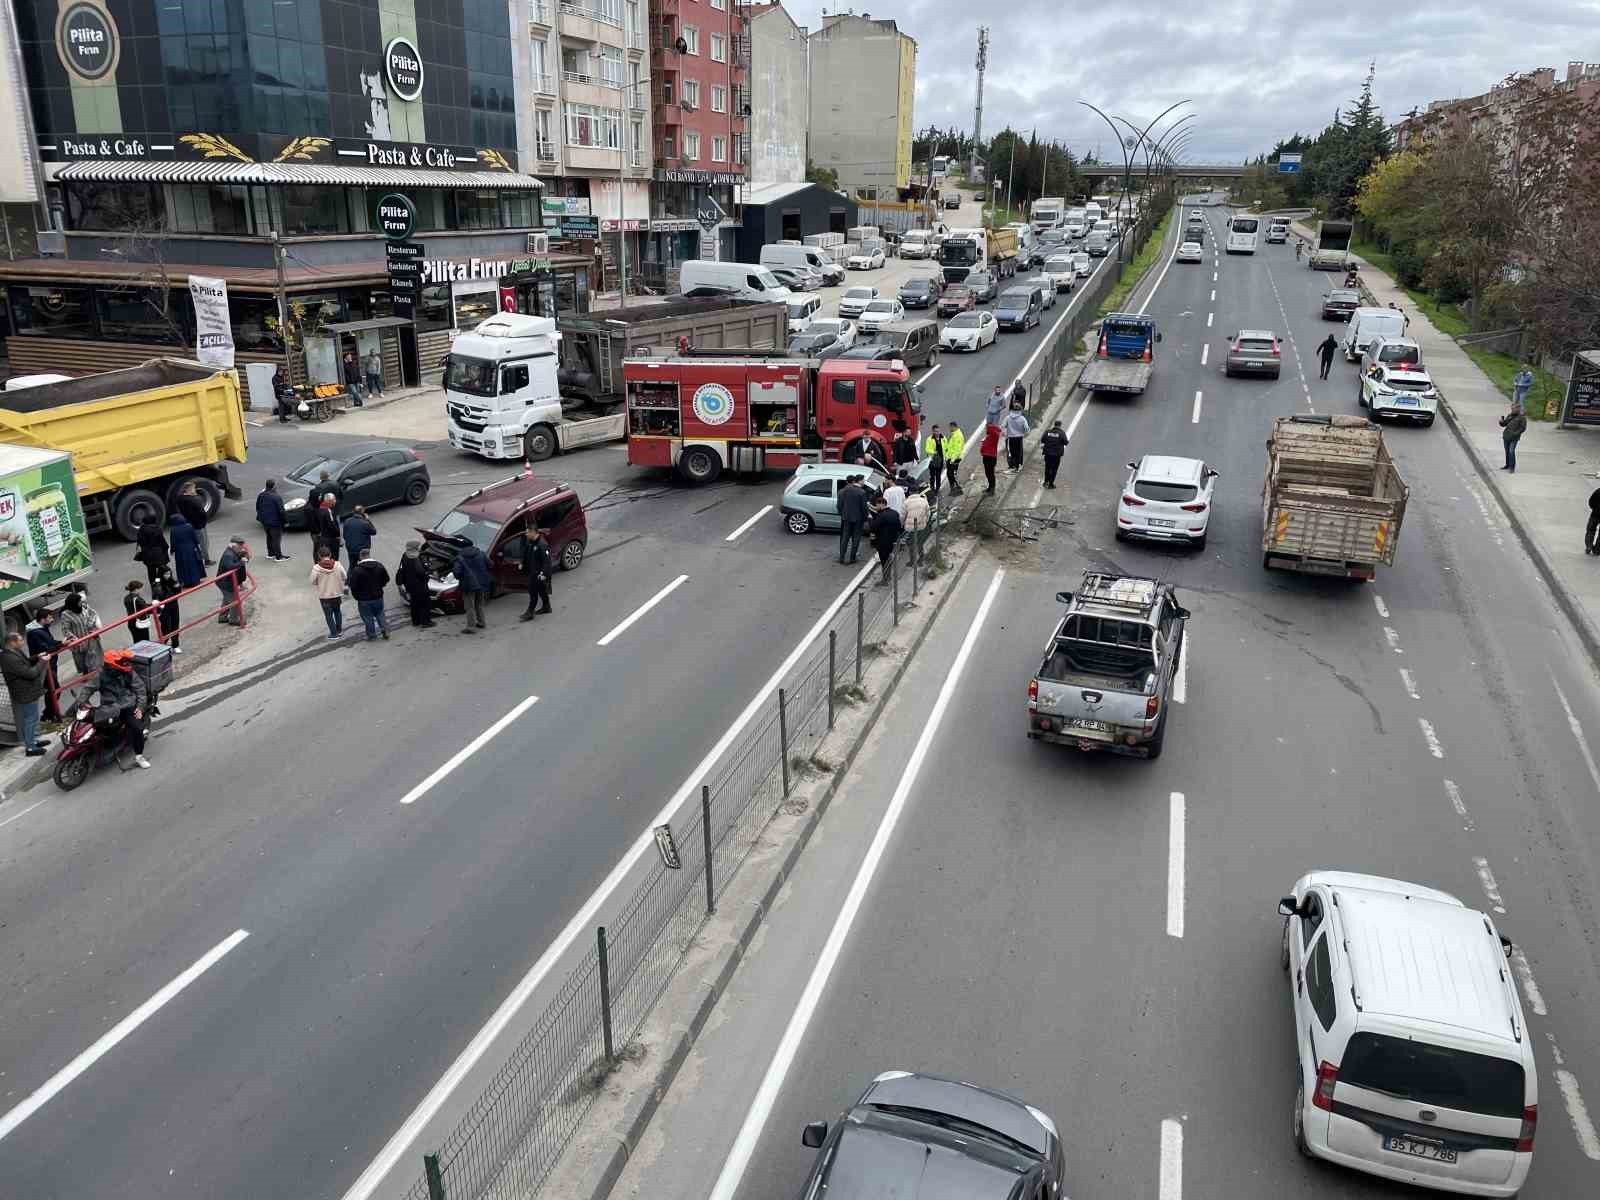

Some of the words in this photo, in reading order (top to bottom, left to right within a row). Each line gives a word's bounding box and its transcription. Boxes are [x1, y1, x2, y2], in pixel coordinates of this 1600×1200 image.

[70, 28, 104, 43] Pilita
[391, 54, 418, 71] Pilita
[63, 140, 97, 155] Pasta
[99, 140, 111, 155] &
[114, 140, 145, 155] Cafe
[367, 143, 406, 165] Pasta
[410, 146, 422, 166] &
[425, 147, 455, 167] Cafe
[380, 206, 409, 218] Pilita
[420, 260, 468, 283] Pilita
[470, 258, 508, 280] Fırın
[199, 286, 223, 297] Pilita
[1391, 1139, 1405, 1151] 35
